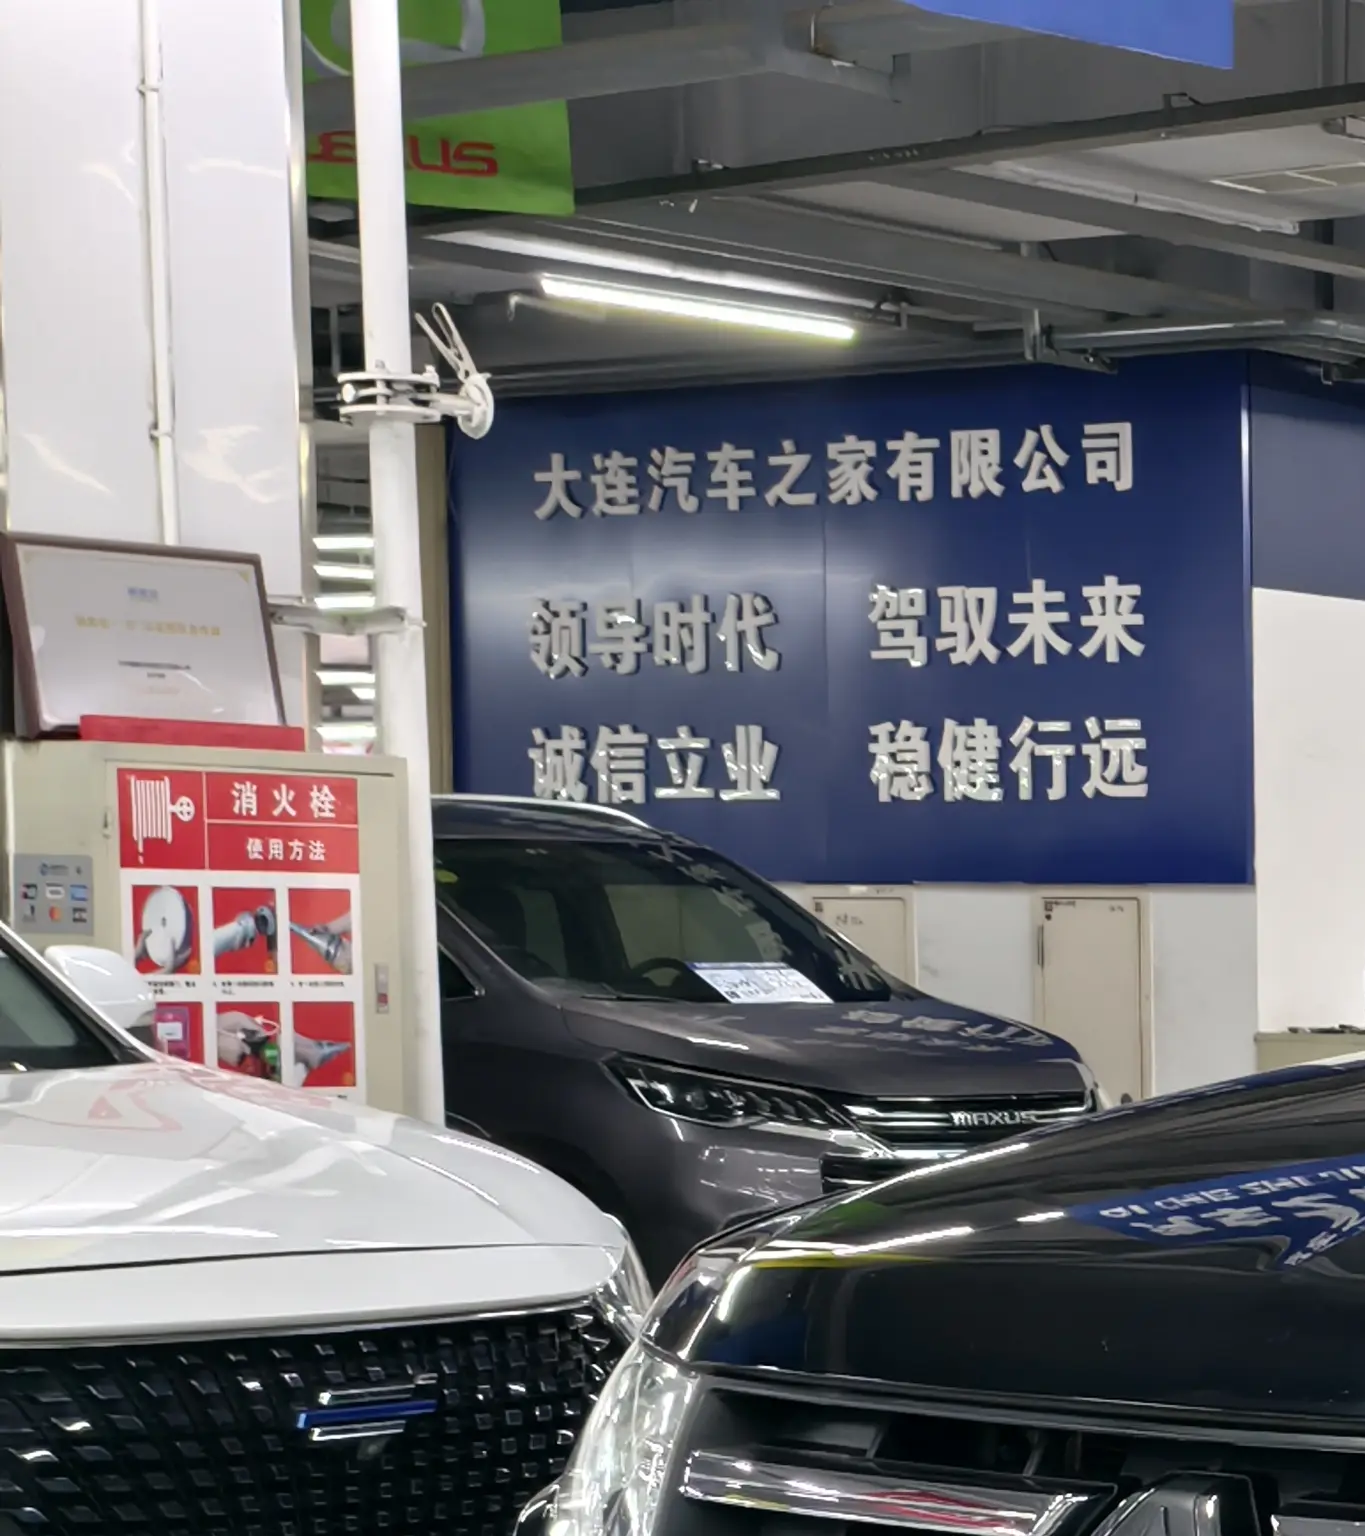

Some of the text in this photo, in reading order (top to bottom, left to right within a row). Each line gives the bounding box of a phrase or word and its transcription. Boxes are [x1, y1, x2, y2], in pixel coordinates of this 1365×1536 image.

[533, 422, 1134, 519] 大连汽车之家有限公司
[529, 576, 1146, 678] 领导时代 驾驭未来
[528, 716, 1149, 804] 诚信立业 稳健行远
[231, 781, 337, 819] 消火栓
[246, 837, 327, 863] 使用方法
[950, 1110, 1038, 1127] MAXUS
